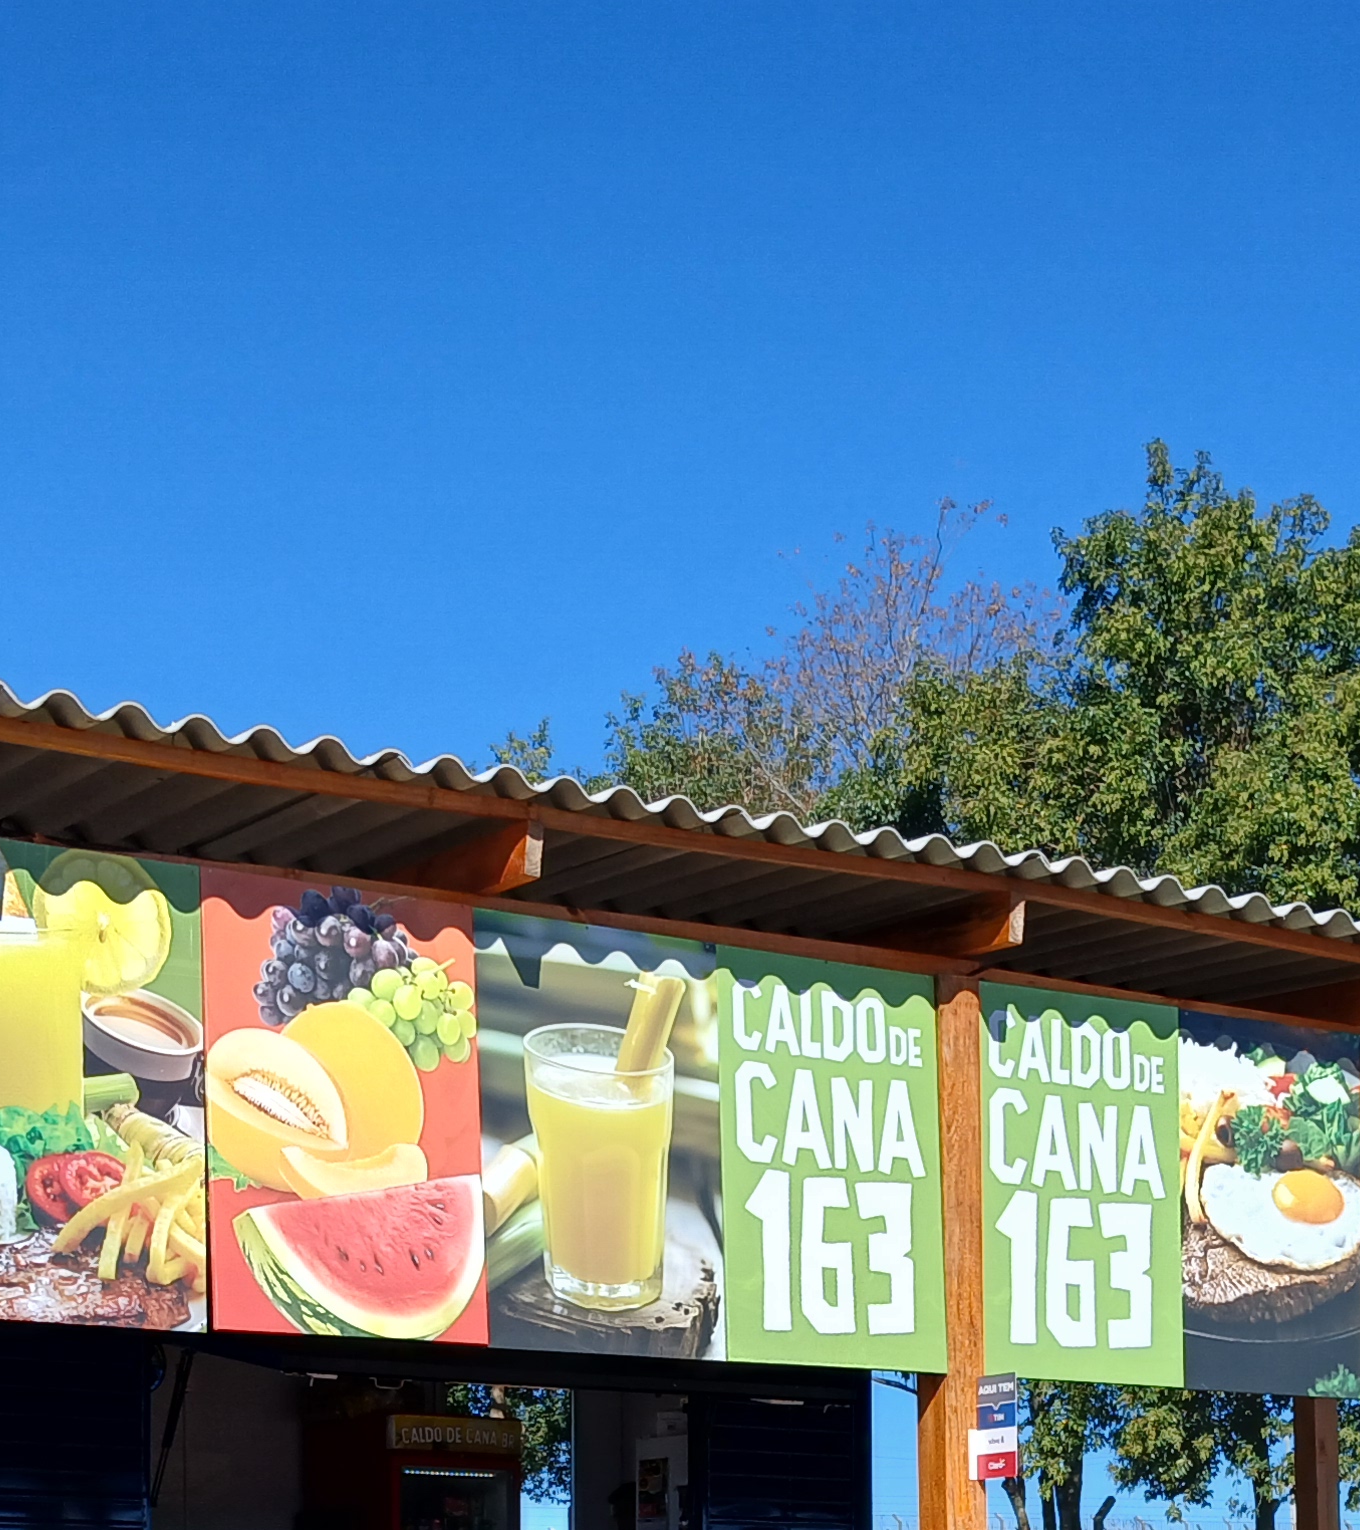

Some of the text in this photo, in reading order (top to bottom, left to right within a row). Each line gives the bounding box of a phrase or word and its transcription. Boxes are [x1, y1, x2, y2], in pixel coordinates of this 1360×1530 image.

[731, 981, 923, 1068] CALDO DE
[987, 1004, 1165, 1095] CALDO DE
[735, 1060, 925, 1179] CANA
[988, 1086, 1166, 1200] CANA
[745, 1169, 915, 1336] 163
[994, 1190, 1152, 1349] 163
[401, 1426, 442, 1444] CALDO
[446, 1427, 462, 1444] DE
[466, 1428, 497, 1446] CANA
[978, 1382, 1014, 1396] AQUI TEM
